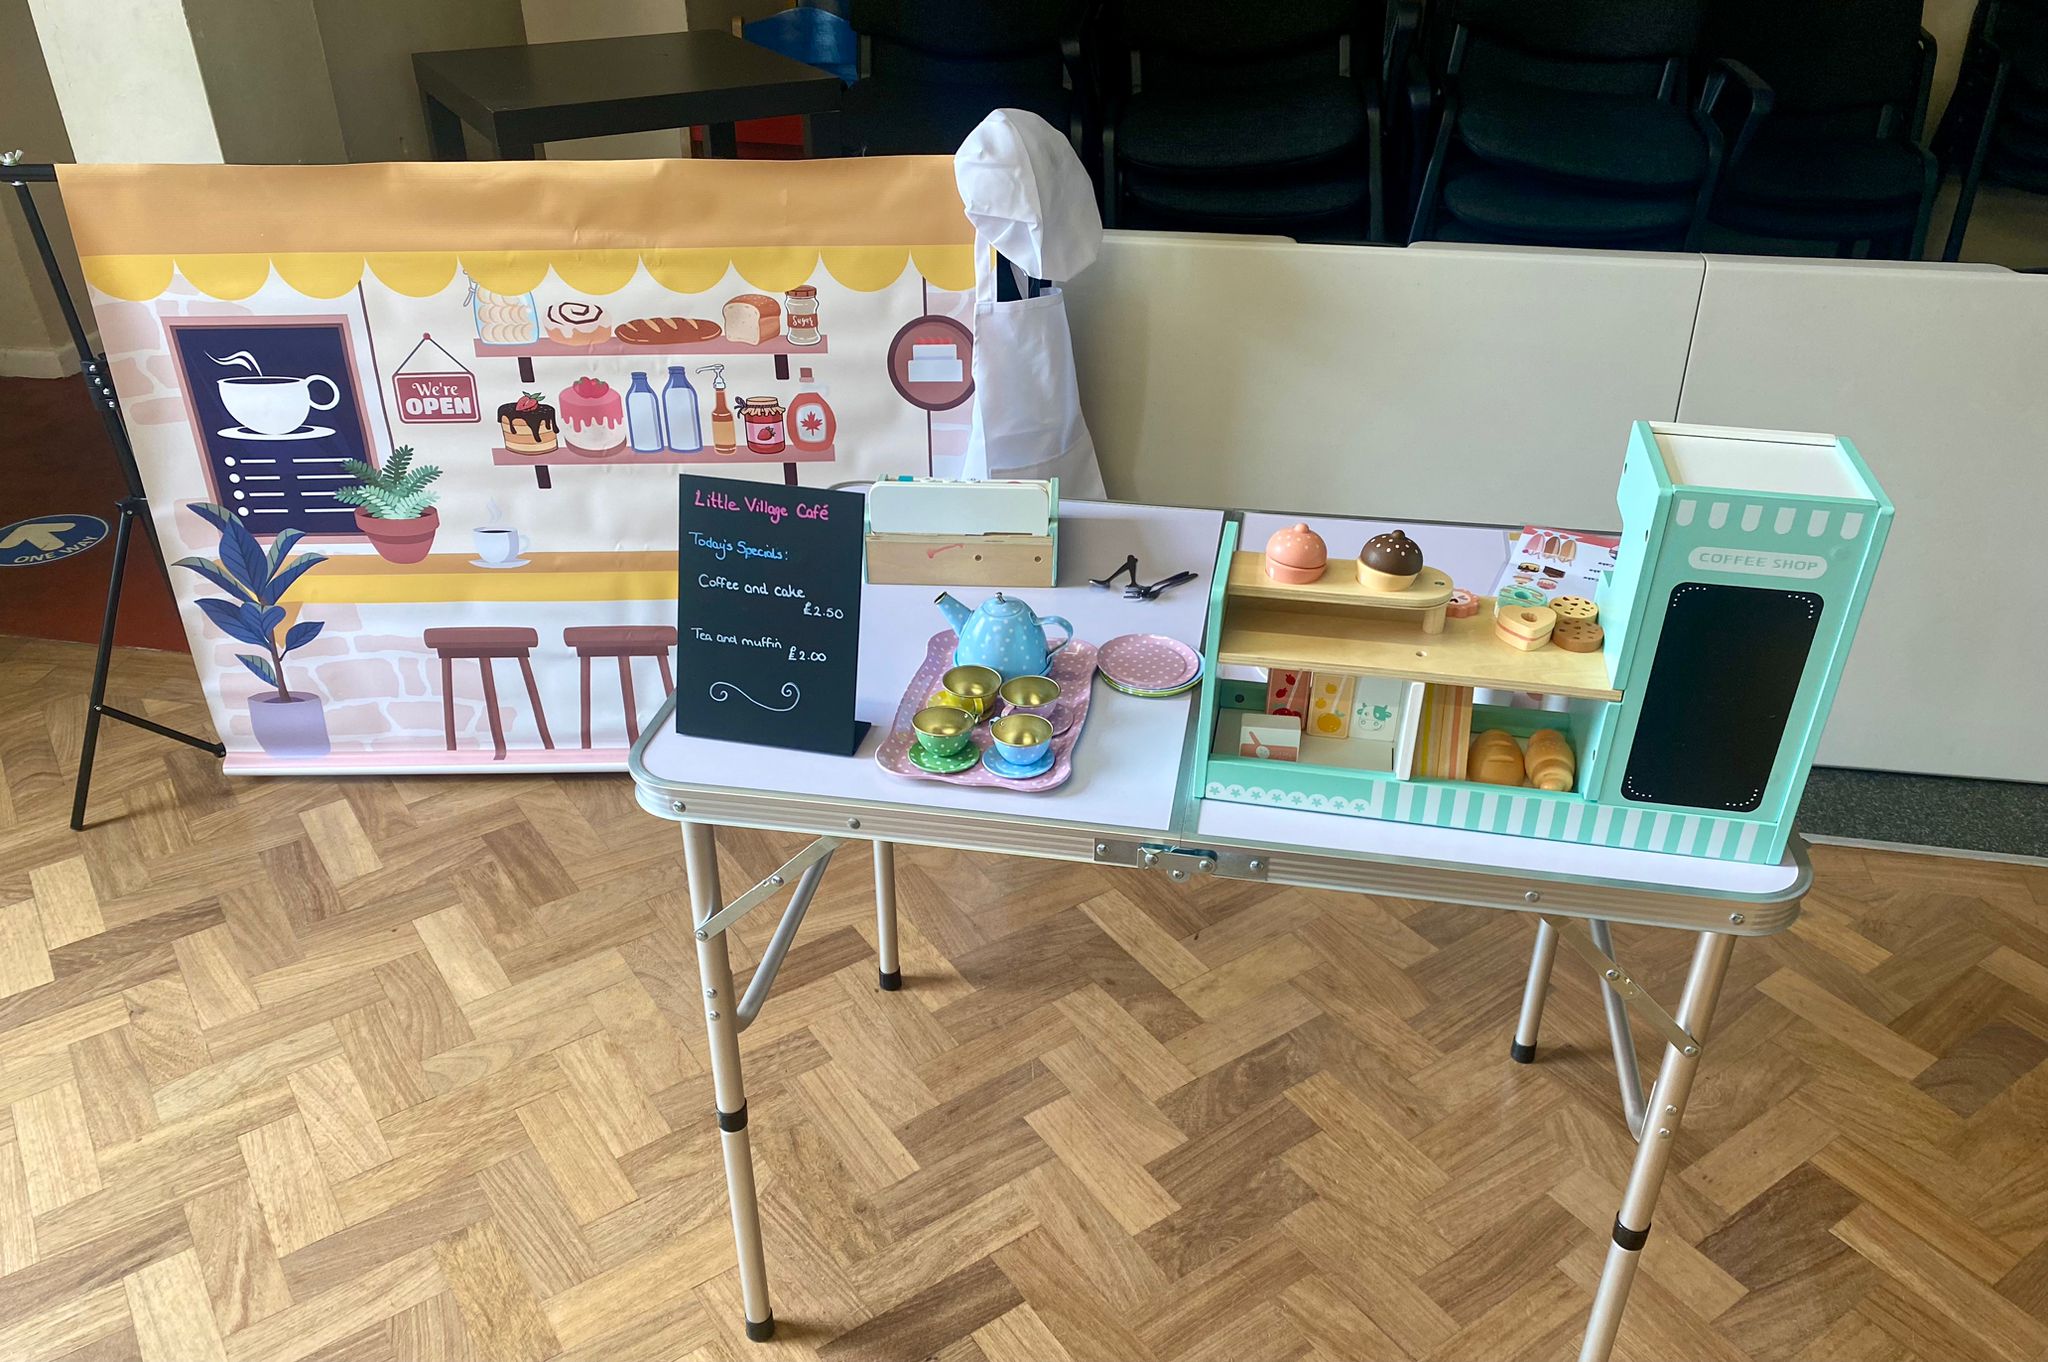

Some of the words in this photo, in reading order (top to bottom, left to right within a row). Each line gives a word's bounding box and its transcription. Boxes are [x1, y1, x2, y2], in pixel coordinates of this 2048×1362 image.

[792, 315, 814, 327] Sugar
[411, 381, 459, 396] We're
[405, 397, 472, 415] OPEN
[694, 489, 740, 511] Little
[744, 496, 788, 524] Village
[796, 503, 829, 521] Café
[14, 551, 56, 564] ONE
[59, 535, 98, 554] WAY
[688, 531, 733, 560] Today's
[1699, 552, 1768, 568] COFFEE
[1772, 558, 1819, 571] SHOP
[698, 573, 740, 591] Coffee
[744, 582, 769, 595] and
[774, 584, 806, 598] cake
[803, 601, 844, 620] £2.50
[691, 627, 713, 642] Tea
[716, 633, 738, 645] and
[741, 636, 782, 649] muffin
[788, 645, 827, 662] £2.00
